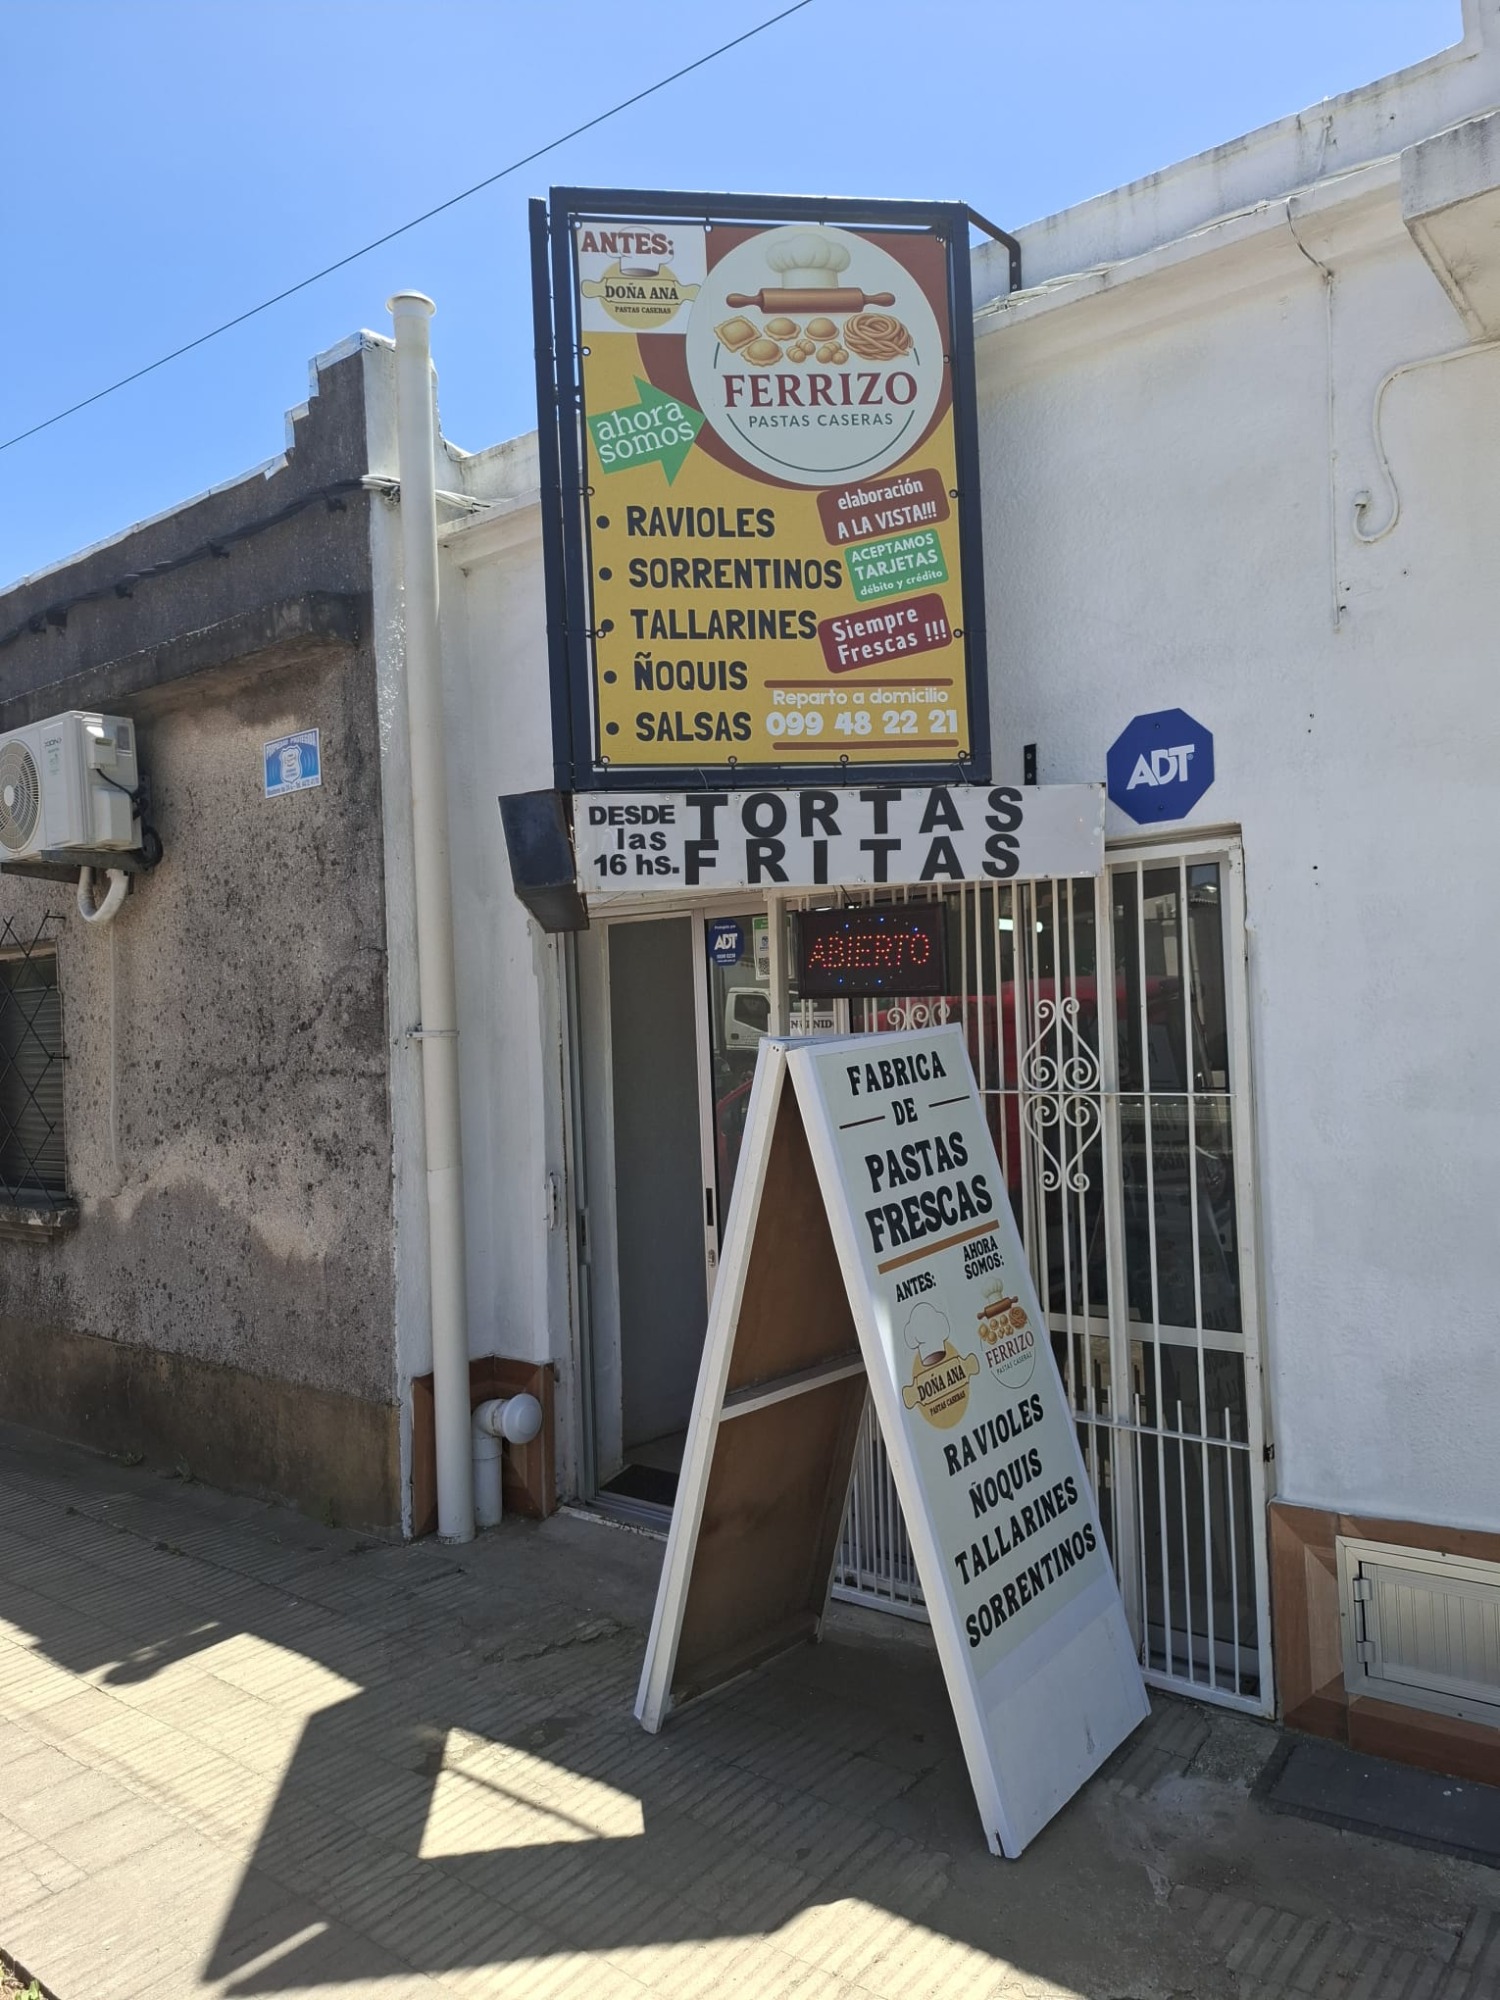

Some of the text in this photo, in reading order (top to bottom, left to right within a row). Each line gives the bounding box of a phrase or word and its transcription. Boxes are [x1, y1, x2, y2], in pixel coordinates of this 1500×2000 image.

[580, 231, 674, 255] ANTES:
[605, 282, 679, 300] DOÑA ANA
[723, 371, 918, 408] FERRIZO
[596, 402, 684, 441] ahora
[749, 412, 893, 428] PASTAS CASERAS
[598, 421, 694, 463] somos
[838, 478, 924, 510] elaboración
[626, 506, 775, 537] RAVIOLES
[837, 501, 938, 539] A LA VISTA!!!
[851, 533, 934, 563] ACEPTAMOS
[629, 558, 842, 589] SORRENTINOS
[854, 550, 938, 581] TARJETAS
[860, 570, 943, 596] débito y crédito
[630, 609, 817, 640] TALLARINES
[832, 608, 919, 642] Siempre
[837, 619, 947, 665] Frescas !!!
[634, 652, 748, 691] ÑOQUIS
[773, 688, 948, 708] Reparto a domicilio
[635, 711, 751, 741] SALSAS
[765, 709, 958, 736] 099 48 22 21
[1126, 744, 1195, 790] ADT
[588, 805, 676, 826] DESDE
[685, 786, 1024, 840] TORTAS
[617, 828, 667, 851] las
[593, 854, 680, 876] 16 hs.
[684, 833, 1021, 886] FRITAS
[714, 932, 738, 950] ADT
[808, 934, 930, 968] ABIERTO
[847, 1051, 947, 1096] FABRICA
[891, 1097, 919, 1126] DE
[864, 1131, 969, 1193] PASTAS
[865, 1174, 993, 1253] FRESCAS
[963, 1235, 999, 1262] AHORA
[964, 1253, 1005, 1280] SOMOS:
[895, 1271, 937, 1303] ANTES:
[985, 1330, 1034, 1368] FERRIZO
[917, 1364, 966, 1401] DOÑA ANA
[943, 1393, 1044, 1476] RAVIOLES
[968, 1448, 1043, 1519] ÑOQUIS
[954, 1476, 1078, 1585] TALLARINES
[965, 1523, 1097, 1648] SORRENTINOS
